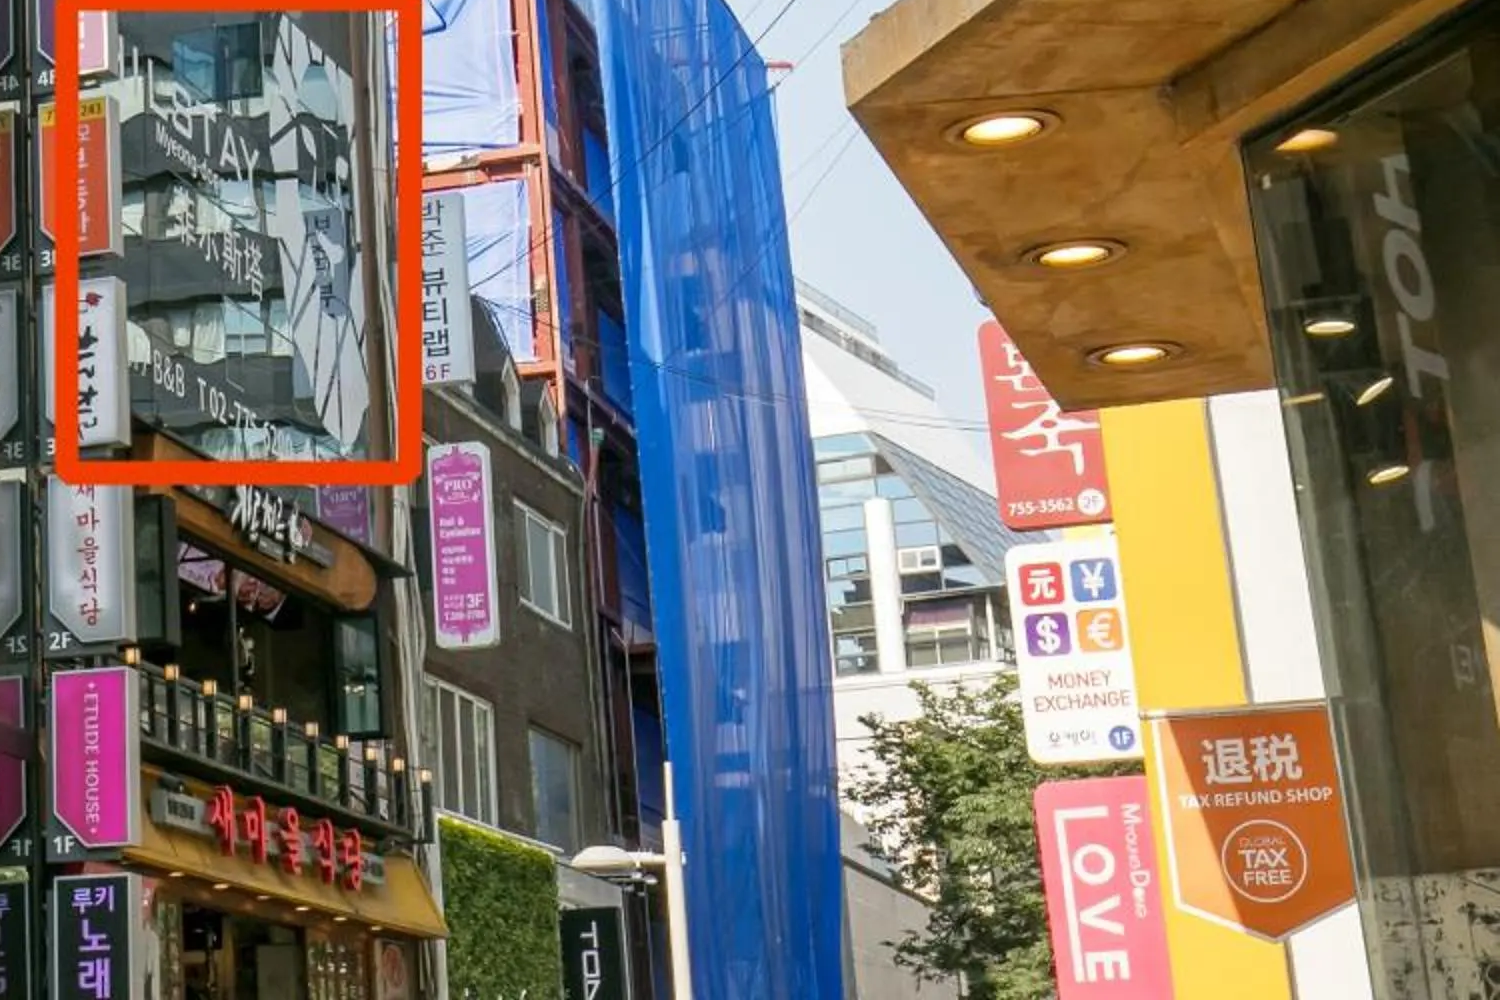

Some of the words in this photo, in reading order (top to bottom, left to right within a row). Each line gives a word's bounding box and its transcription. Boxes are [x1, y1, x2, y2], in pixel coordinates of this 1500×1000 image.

[153, 348, 186, 399] B&B
[443, 479, 474, 493] PRO
[1008, 496, 1075, 517] 755-3562
[1027, 568, 1057, 600] 元
[49, 631, 72, 650] 2F
[1047, 669, 1112, 691] MONEY
[1033, 689, 1131, 714] EXCHANGE
[84, 692, 100, 755] ETUDE
[1113, 731, 1131, 746] 1F
[1201, 732, 1304, 785] 退税
[84, 759, 100, 825] HOUSE
[1178, 792, 1210, 810] TAX
[1214, 788, 1284, 807] REFUND
[1286, 786, 1333, 804] SHOP
[53, 835, 76, 854] 1F
[207, 783, 364, 893] 새마을식당
[1238, 847, 1289, 869] TAX
[1243, 868, 1294, 887] FREE
[71, 884, 116, 914] 루키
[1053, 805, 1131, 984] LOVE
[77, 918, 112, 1000] 노래
